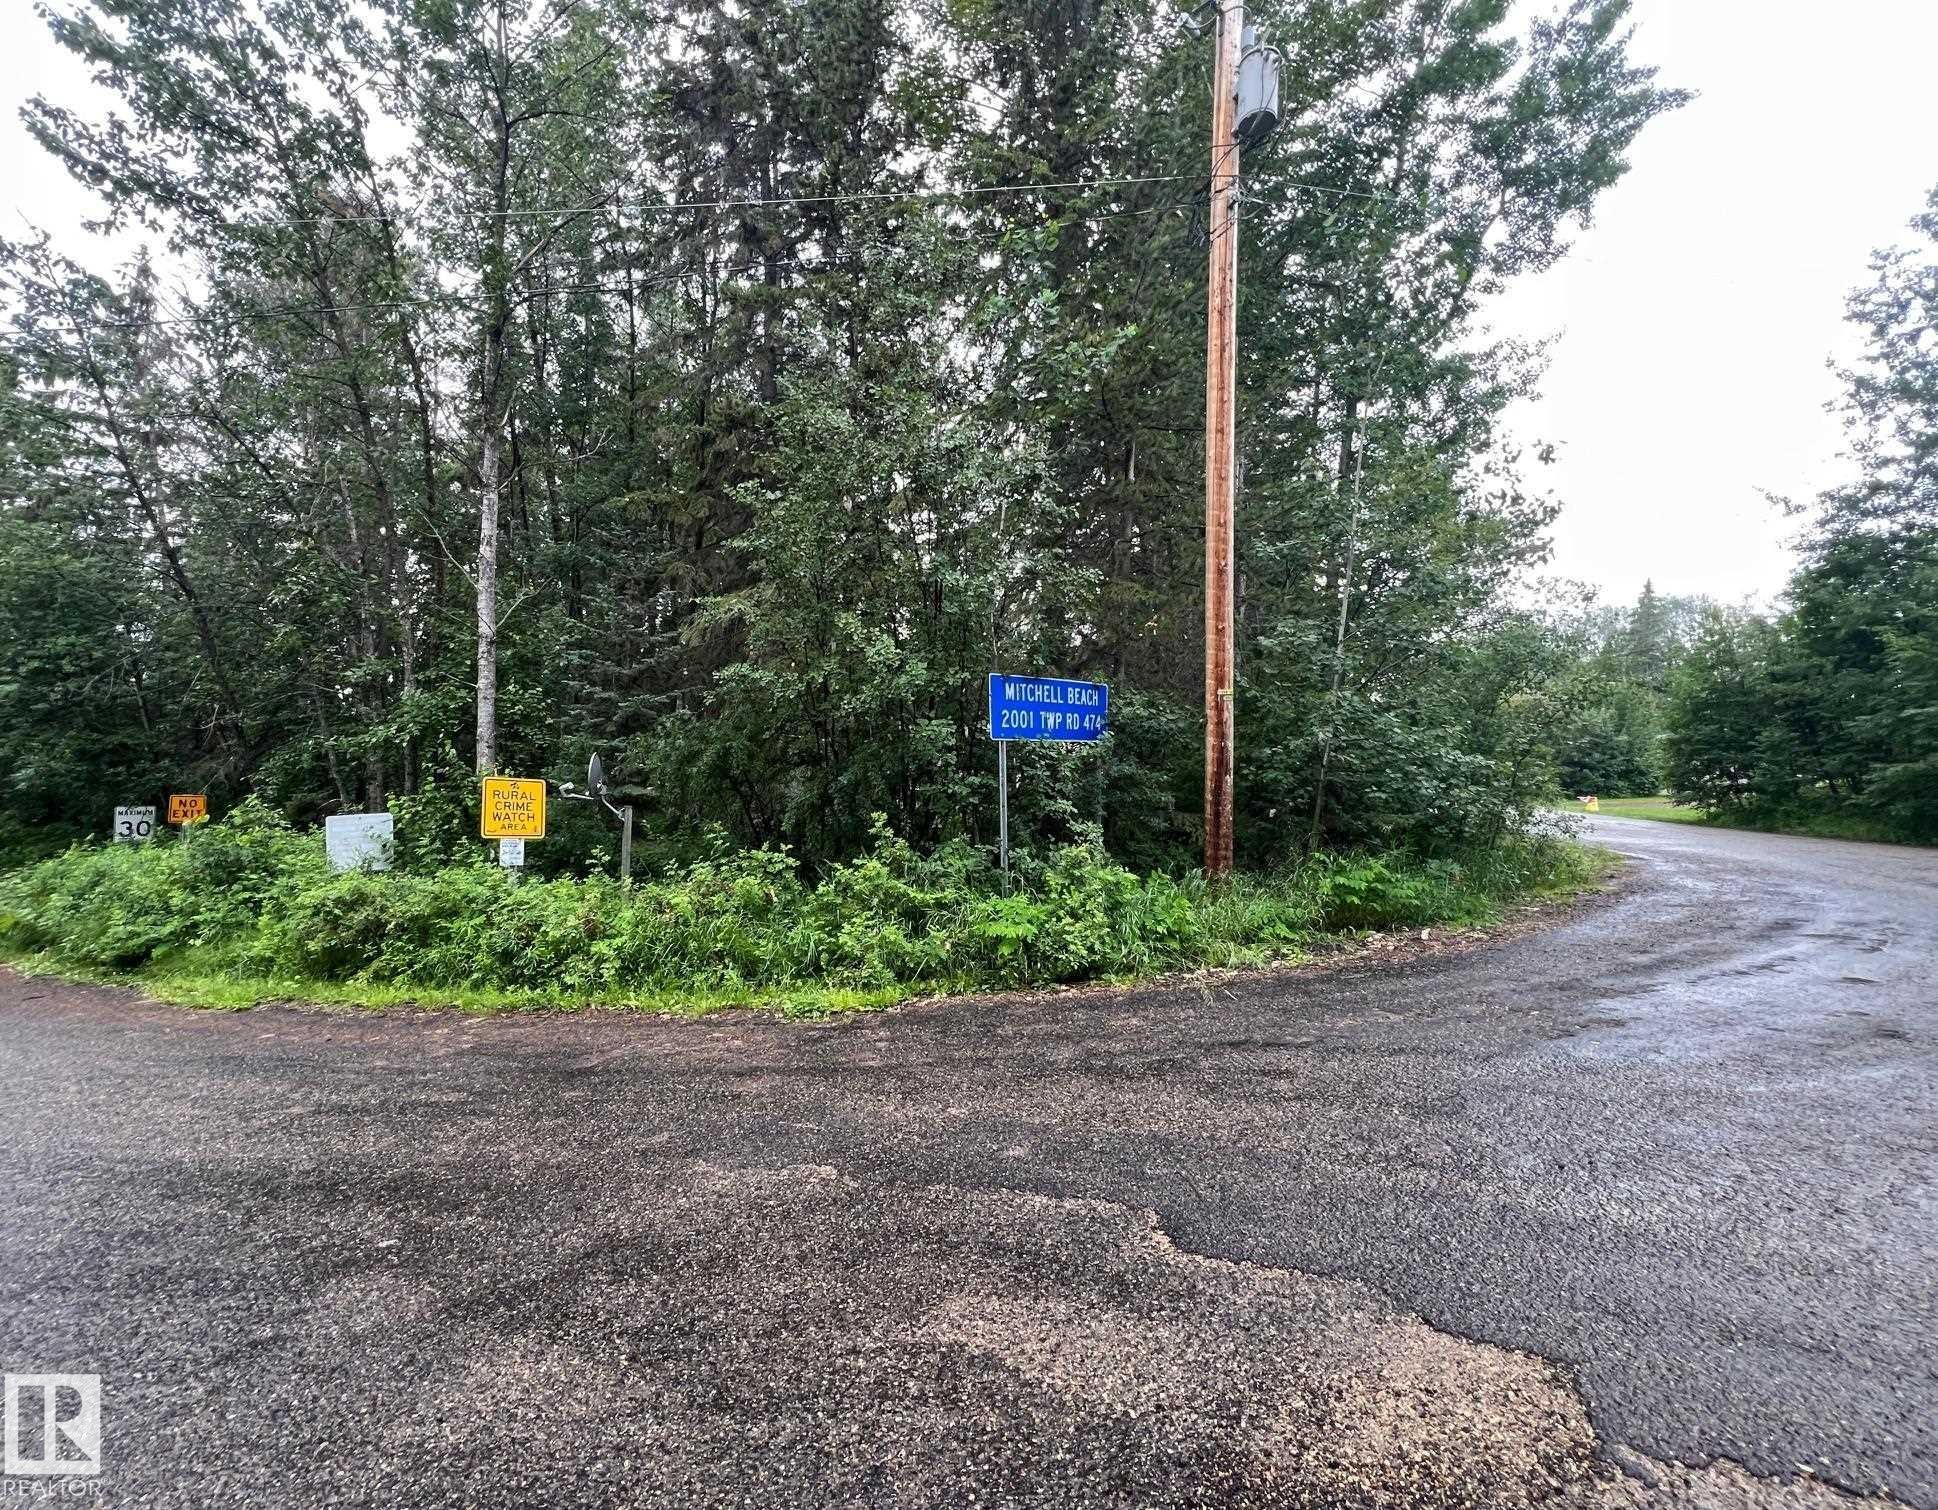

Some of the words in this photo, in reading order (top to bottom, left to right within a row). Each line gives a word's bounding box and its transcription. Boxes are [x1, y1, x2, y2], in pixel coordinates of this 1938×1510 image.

[1005, 682, 1064, 704] MITCHELL
[1067, 687, 1099, 706] BEACH
[1001, 709, 1034, 729] 2001
[1040, 711, 1063, 731] TWP
[1066, 713, 1080, 730] RD
[492, 789, 537, 801] RURAL
[178, 799, 198, 809] NO
[494, 801, 533, 812] CRIME
[117, 809, 153, 817] MAXIMUM
[172, 809, 204, 819] EXIT
[492, 812, 535, 823] WATCH
[119, 820, 151, 838] 30
[500, 823, 527, 831] AREA
